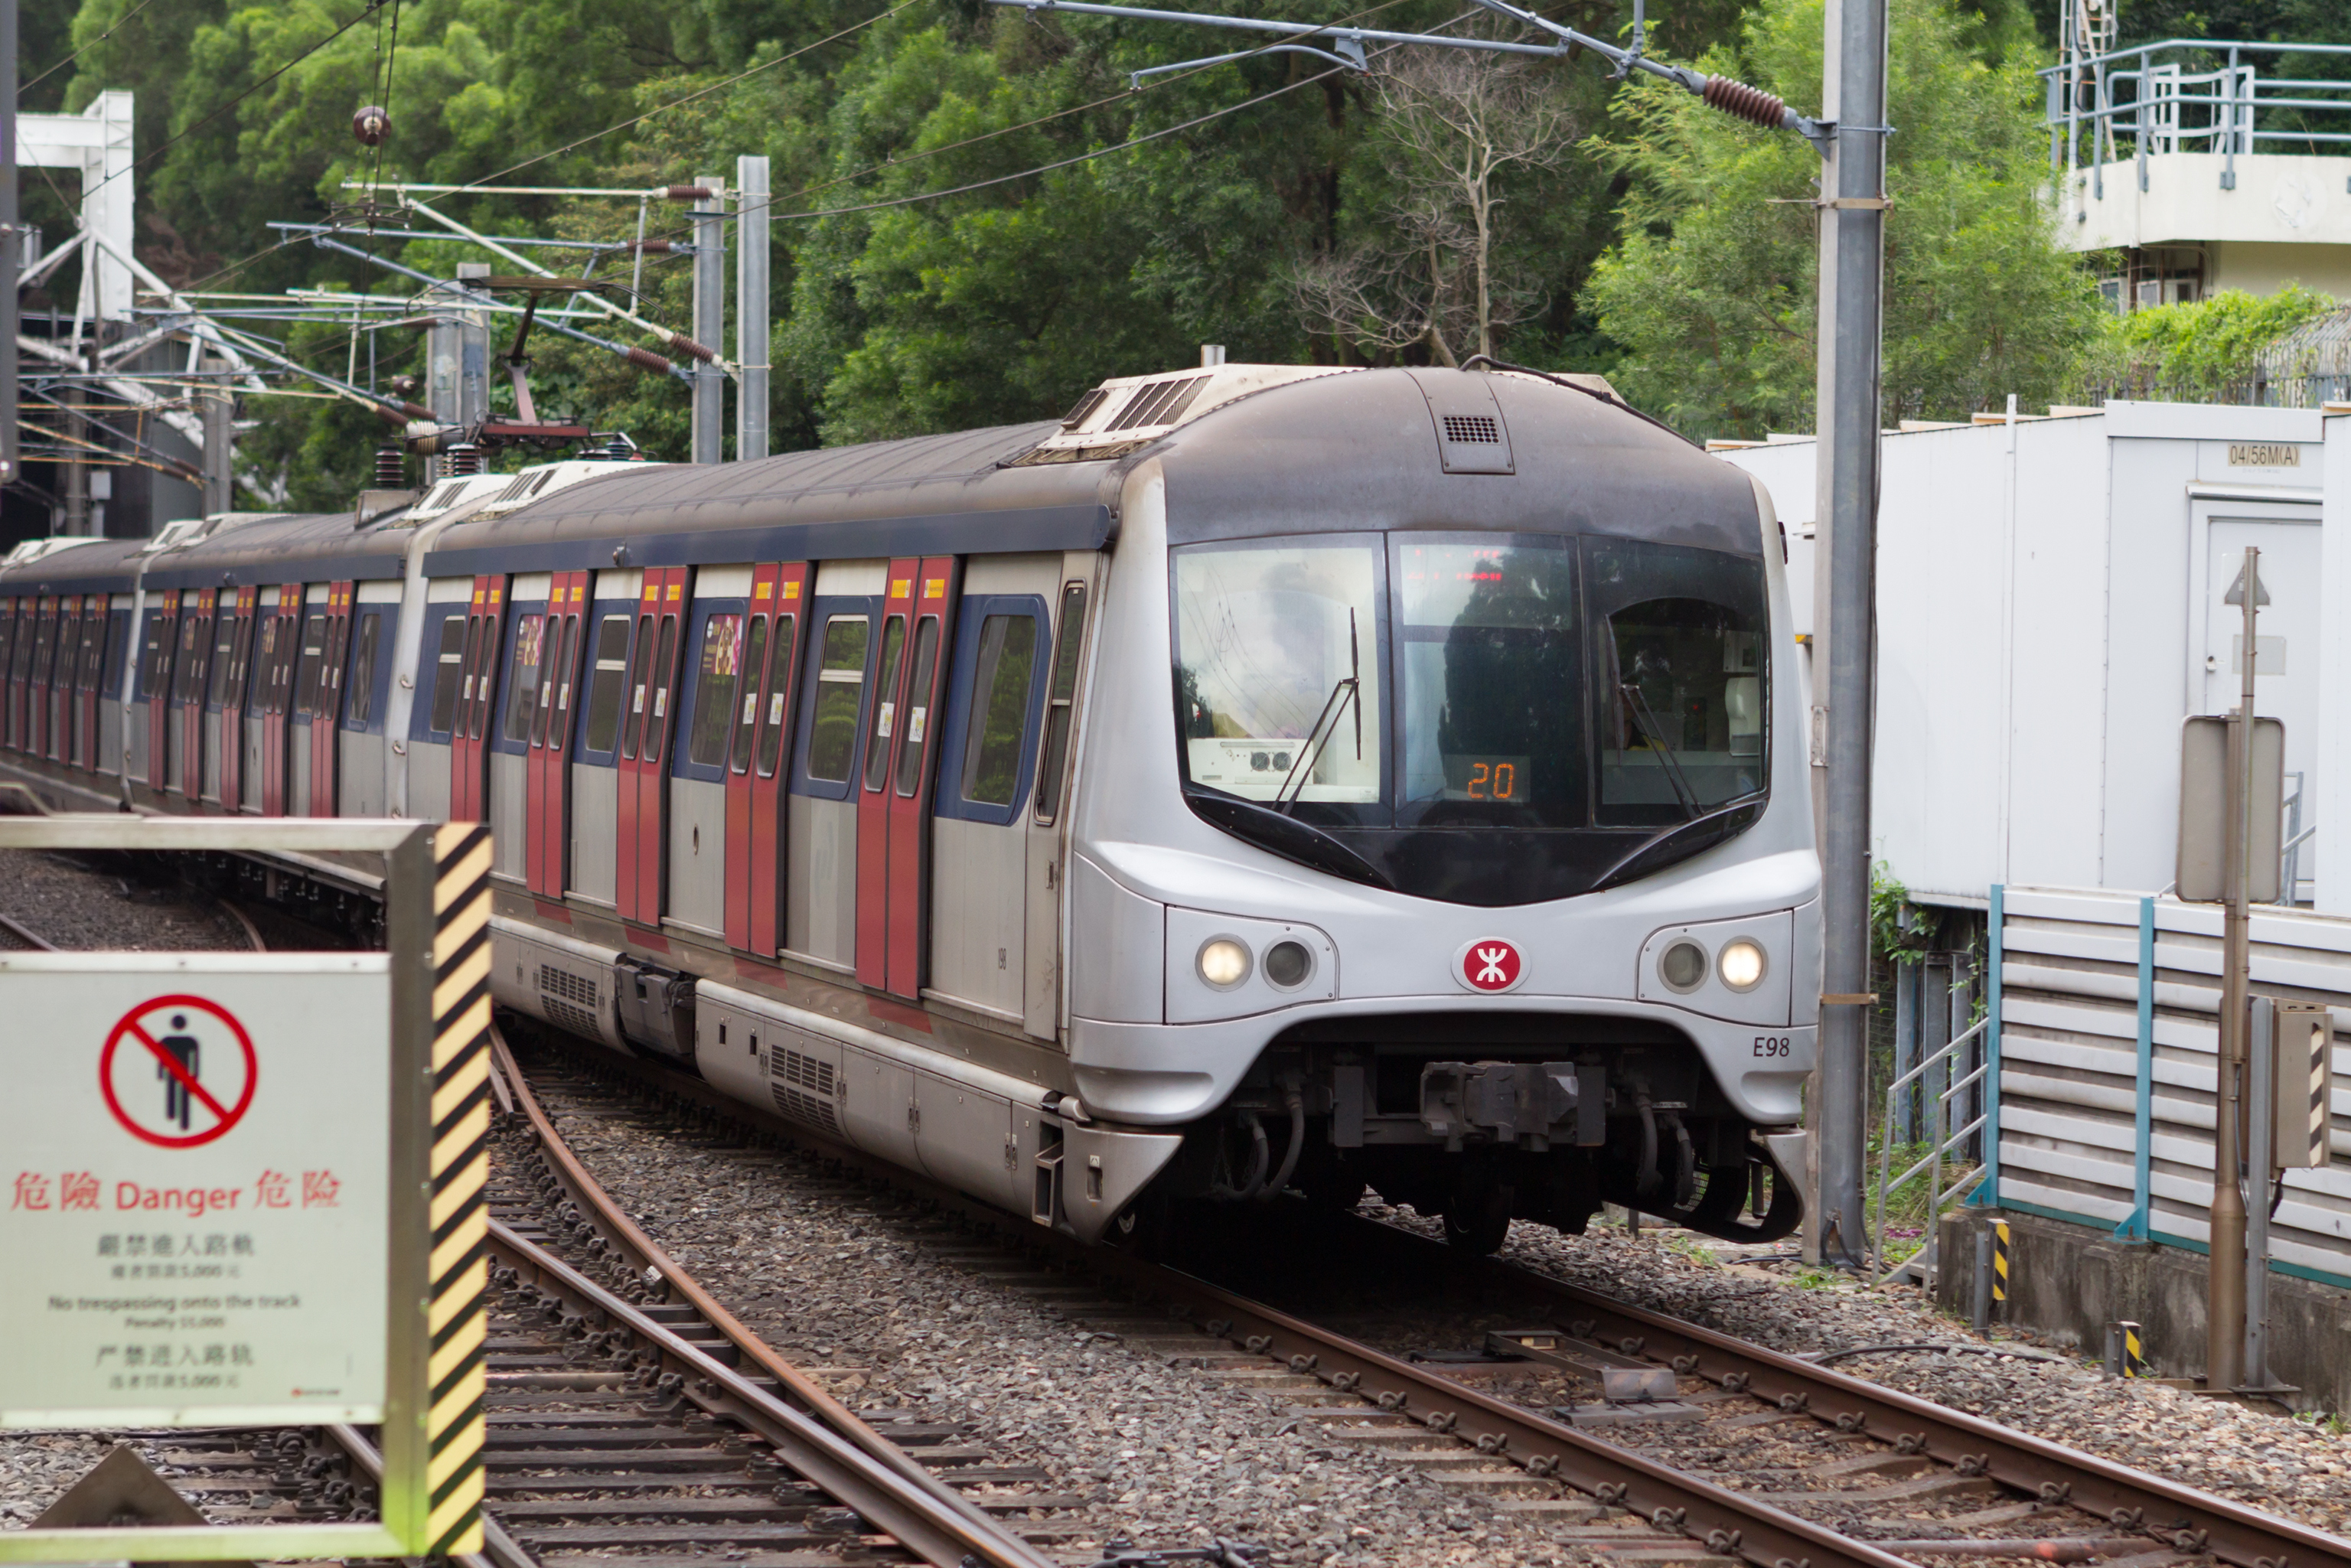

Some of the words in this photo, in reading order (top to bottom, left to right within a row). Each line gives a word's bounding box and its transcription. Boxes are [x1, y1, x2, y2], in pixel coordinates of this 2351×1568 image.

[2230, 445, 2298, 465] 04/56M(A)
[1468, 763, 1514, 798] 20
[1753, 1037, 1790, 1058] E98
[11, 1171, 101, 1211] 危險
[116, 1182, 242, 1218] Danger
[256, 1169, 342, 1209] 危险
[47, 1296, 74, 1310] No
[225, 1294, 254, 1309] the
[257, 1294, 301, 1309] track
